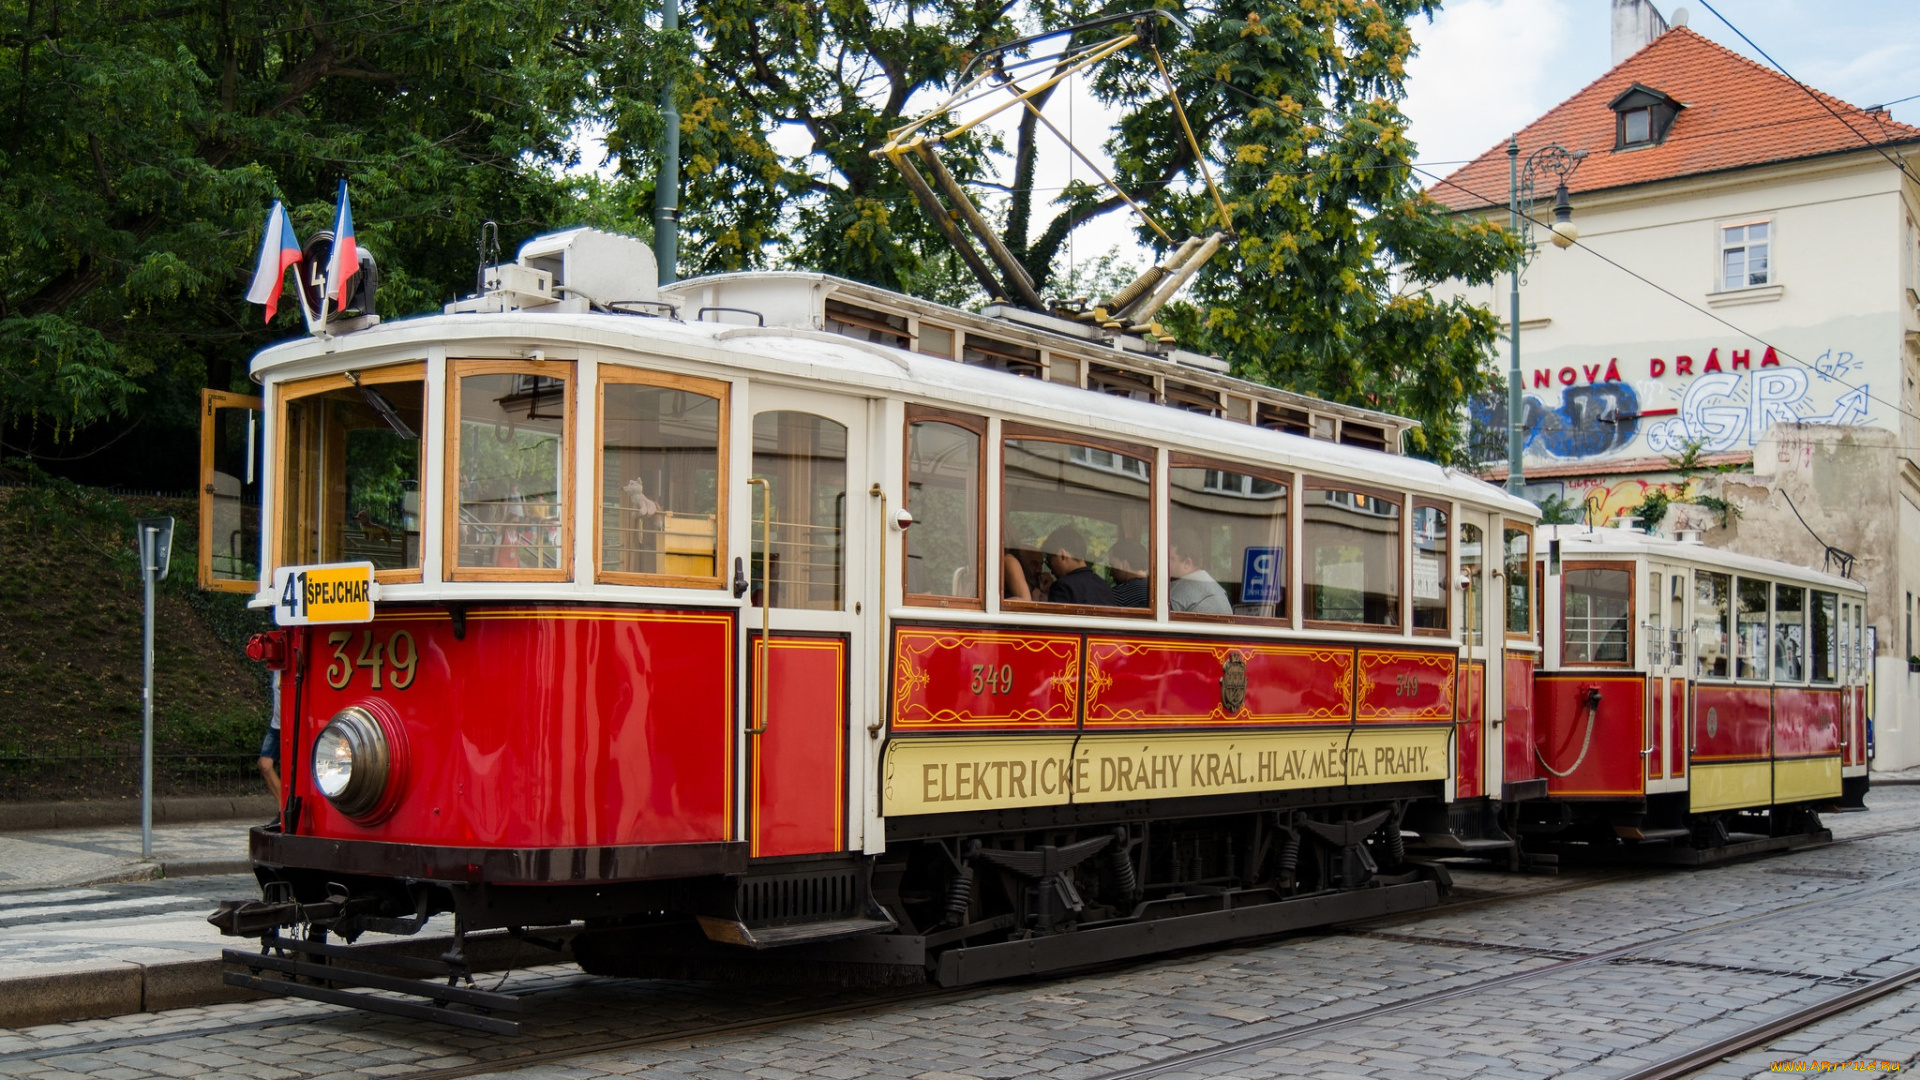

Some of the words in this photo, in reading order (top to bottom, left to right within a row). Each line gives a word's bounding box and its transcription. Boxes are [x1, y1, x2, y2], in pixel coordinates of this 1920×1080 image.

[1650, 345, 1780, 378] DRÁHA
[282, 571, 308, 617] 41
[307, 578, 370, 605] ŠPEJCHAR
[327, 629, 419, 691] 349
[971, 664, 1013, 695] 349
[1395, 674, 1418, 697] 349
[922, 749, 1091, 803] ELEKTRICKÉ
[1100, 746, 1184, 793] DRÁHY
[1307, 742, 1369, 779] MĚSTA
[1374, 746, 1430, 776] PRAHY.
